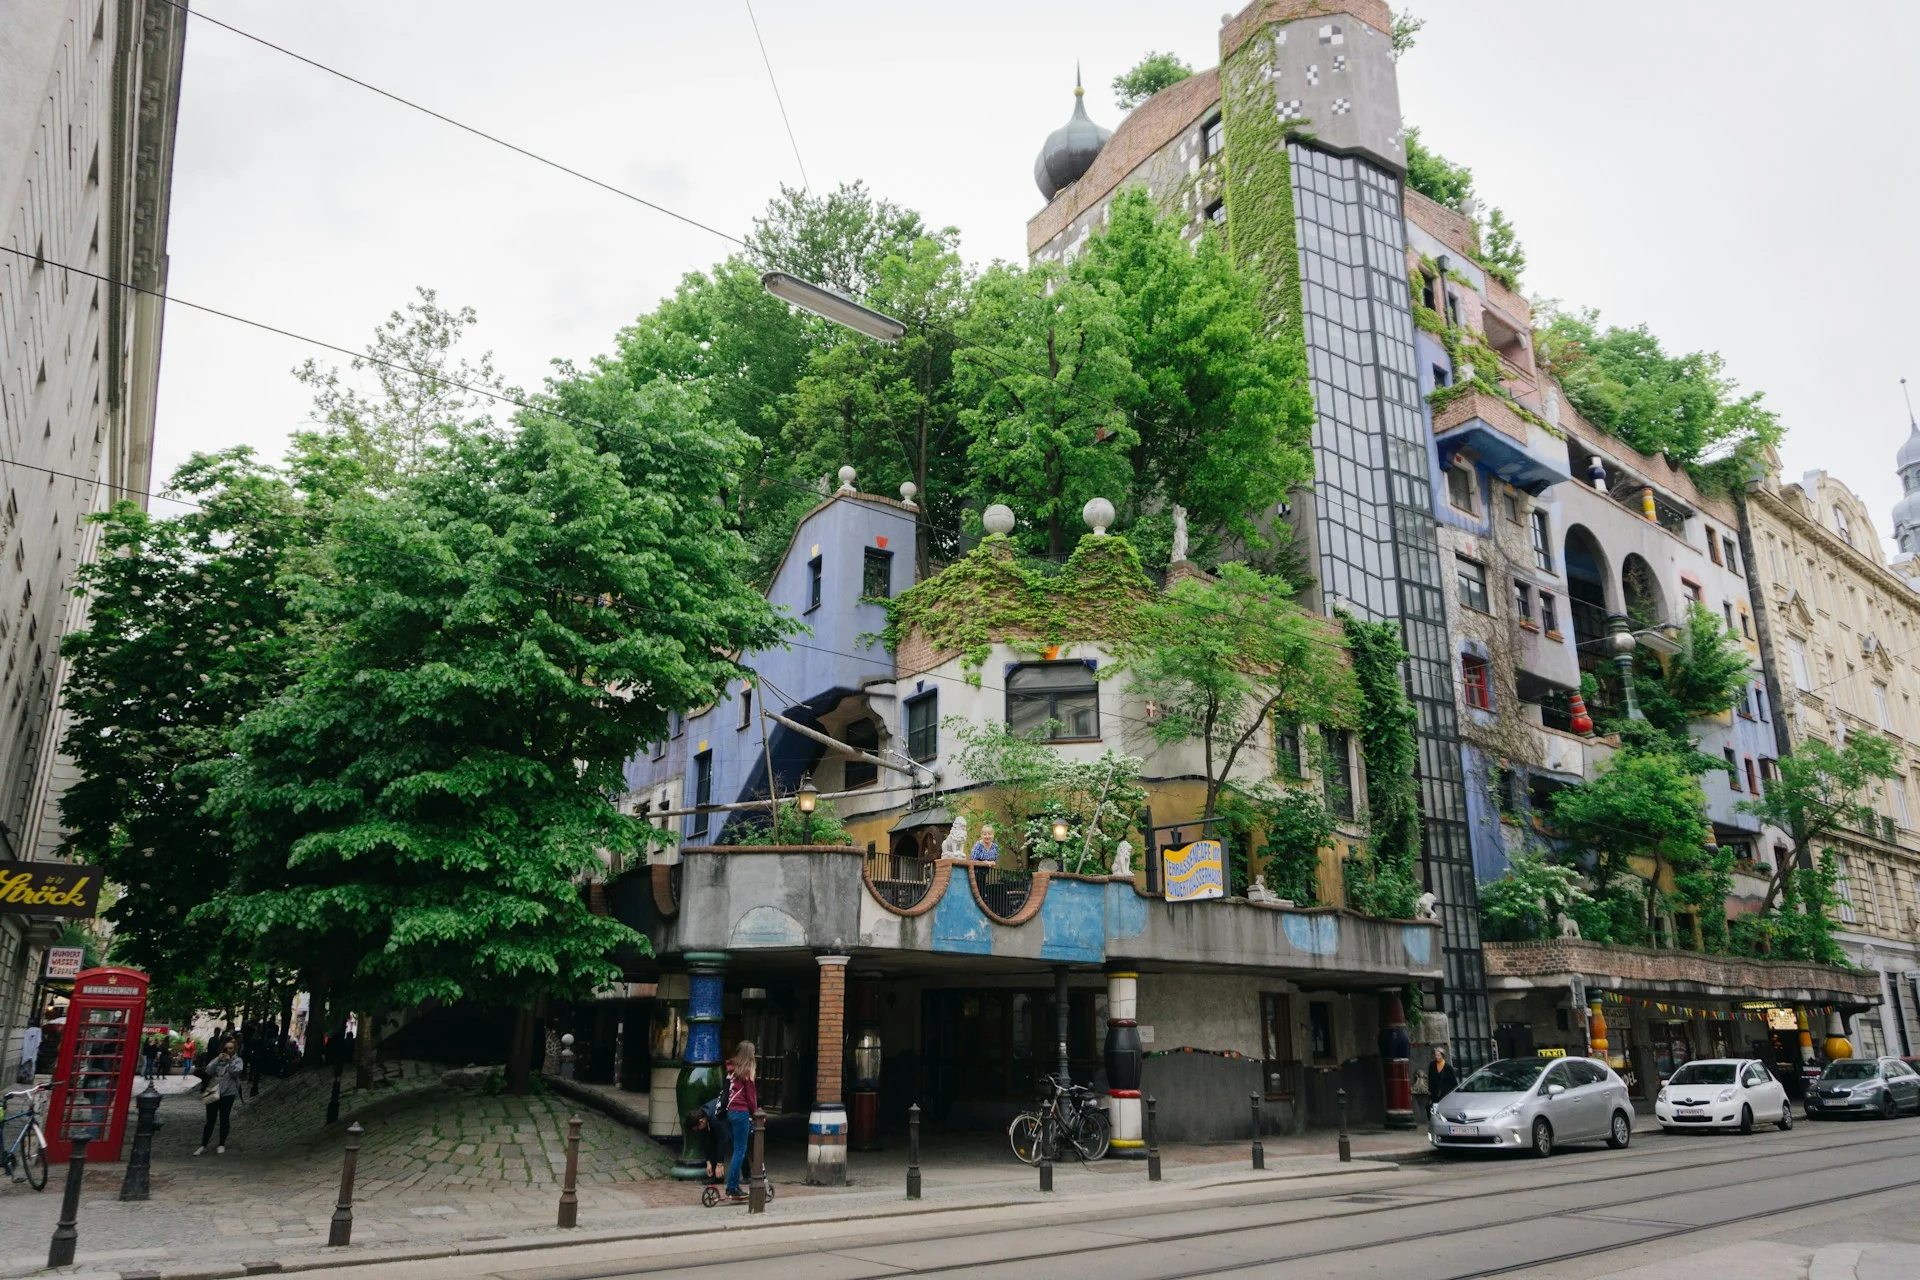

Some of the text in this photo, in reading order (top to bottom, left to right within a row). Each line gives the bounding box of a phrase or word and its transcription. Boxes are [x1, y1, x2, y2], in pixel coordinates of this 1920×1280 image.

[1166, 867, 1221, 897] HUNDERTWASSERHAUS
[0, 869, 91, 907] Ströck
[51, 949, 81, 958] HUNDERT
[51, 958, 79, 966] WASSER
[86, 986, 137, 995] TELEPHONE
